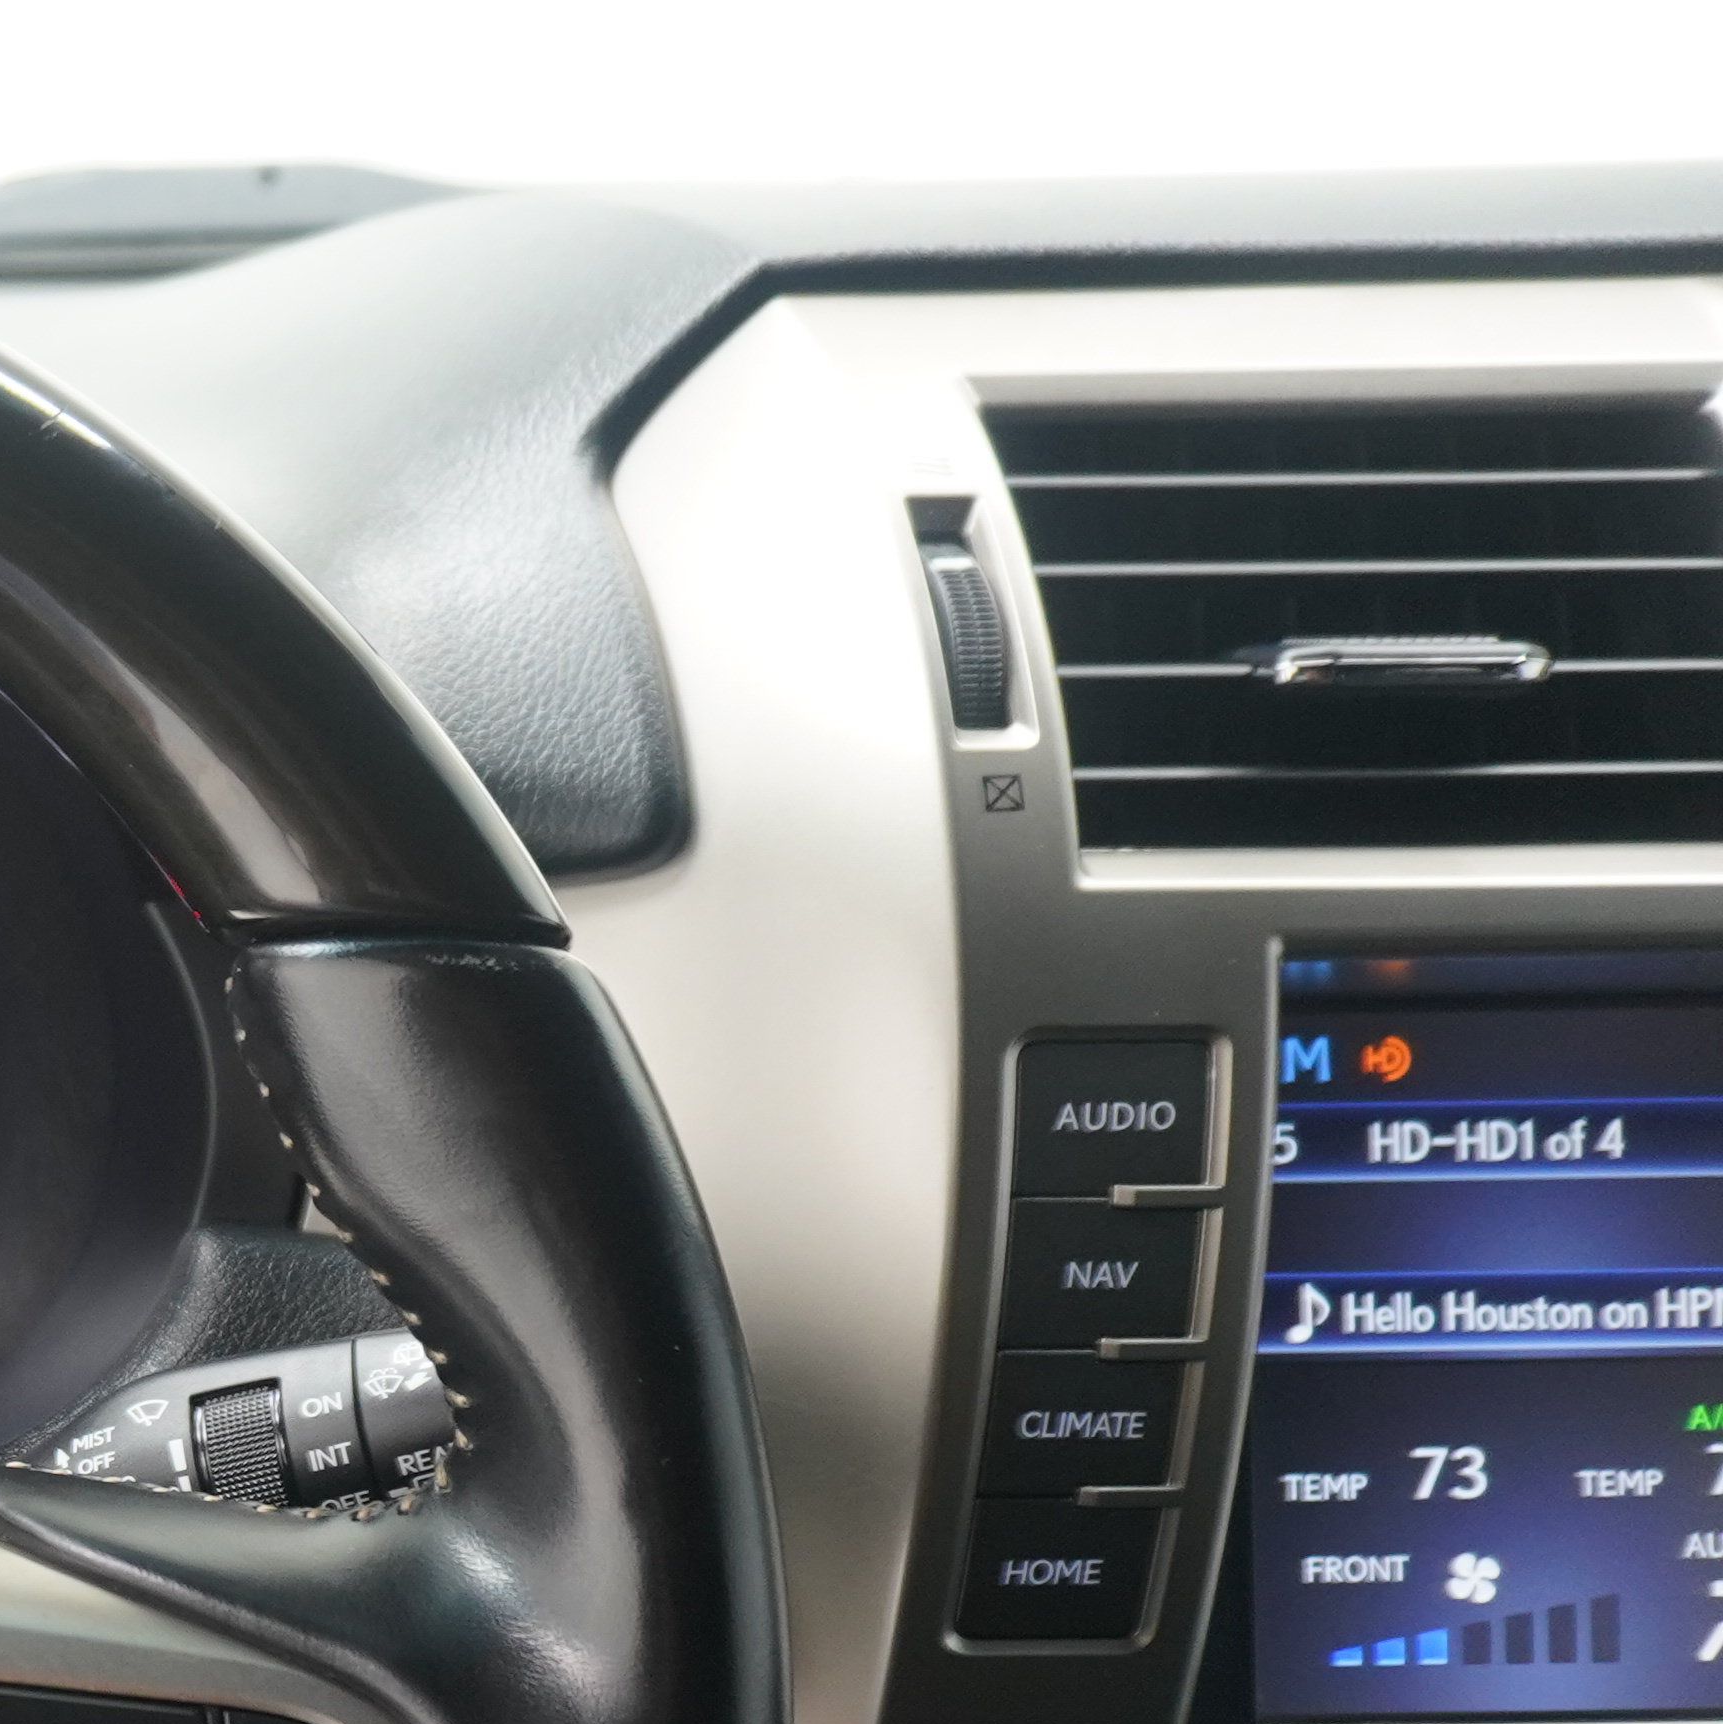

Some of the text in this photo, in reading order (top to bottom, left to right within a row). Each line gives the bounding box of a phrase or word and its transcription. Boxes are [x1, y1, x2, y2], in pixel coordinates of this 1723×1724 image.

[1053, 1100, 1178, 1133] AUDIO
[1365, 1118, 1537, 1165] HD-HD1
[1543, 1116, 1586, 1161] of
[1592, 1116, 1627, 1158] 4
[1063, 1259, 1140, 1291] NAV
[1339, 1291, 1437, 1337] Hello
[1441, 1288, 1594, 1334] Houston
[1600, 1300, 1649, 1331] on
[299, 1391, 343, 1419] ON
[71, 1425, 116, 1454] MIST
[1014, 1410, 1148, 1441] CLIMATE
[77, 1450, 117, 1476] OFF
[307, 1441, 353, 1474] INT
[397, 1442, 454, 1477] REA
[1279, 1471, 1370, 1504] TEMP
[1407, 1444, 1490, 1501] 73
[1573, 1468, 1665, 1498] TEMP
[998, 1557, 1106, 1588] HOME
[1300, 1554, 1411, 1585] FRONT
